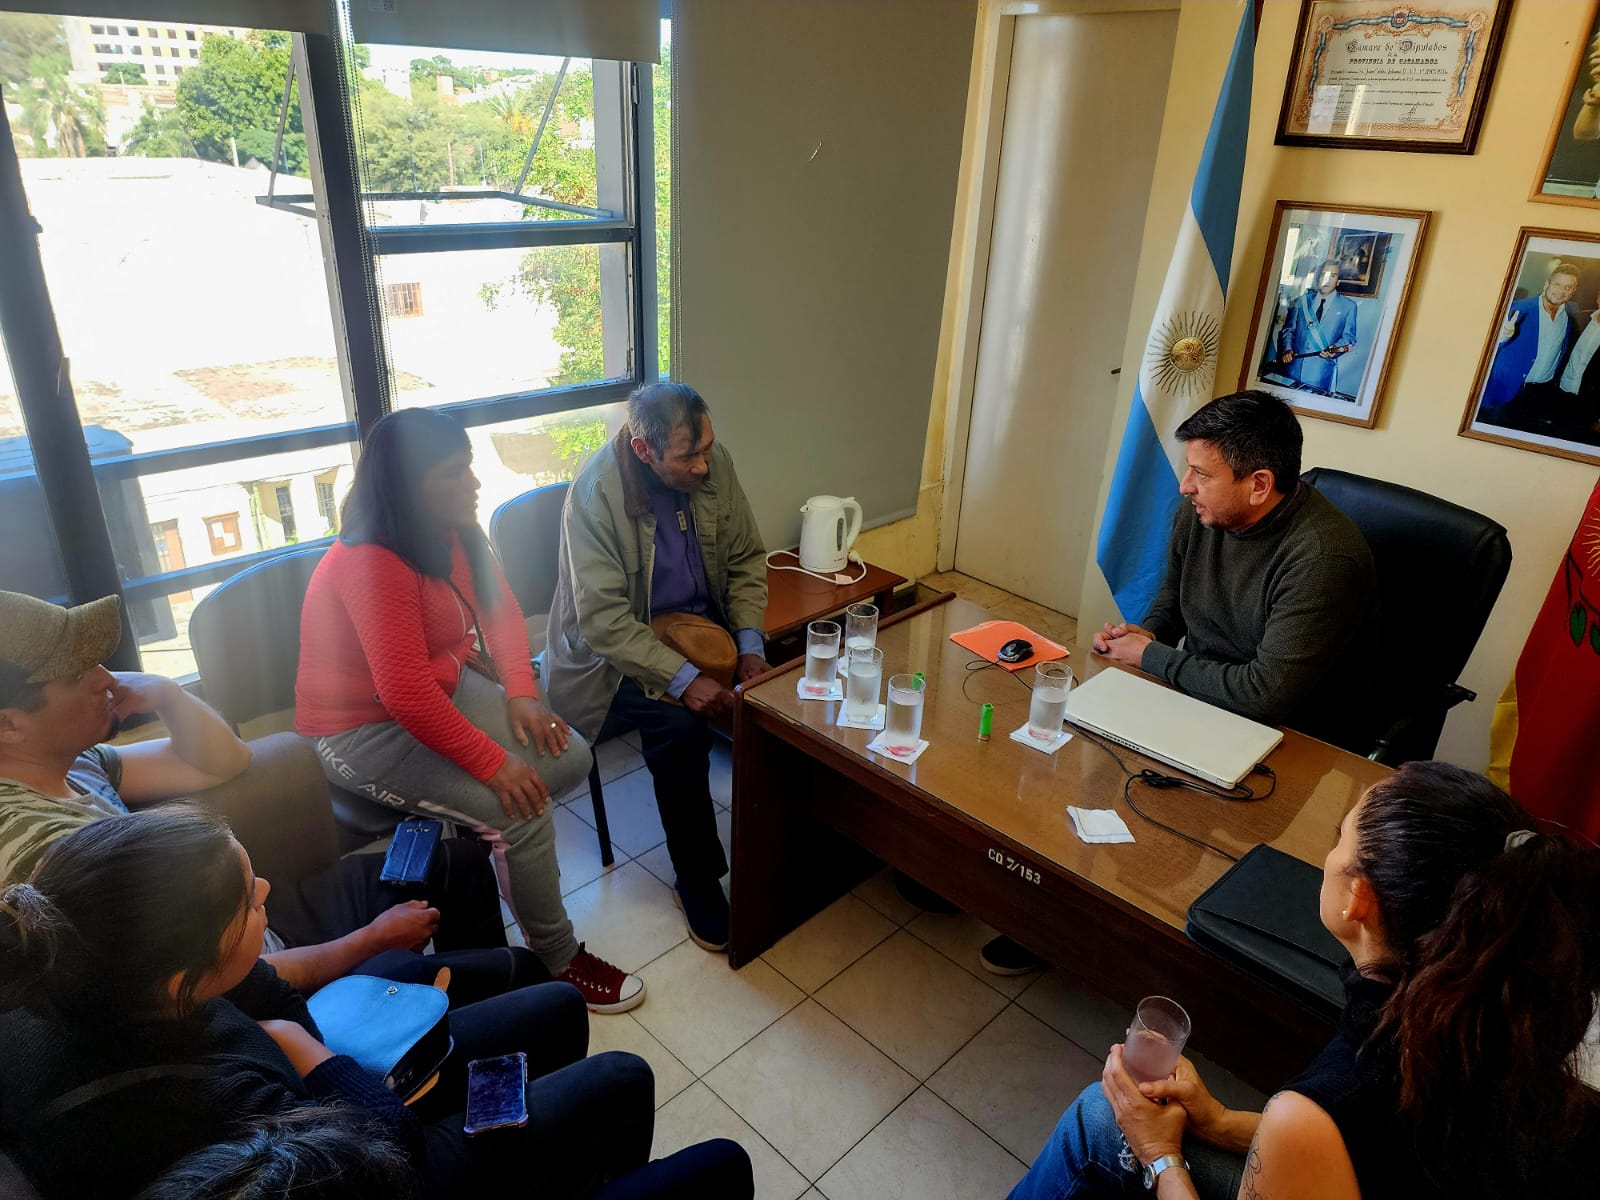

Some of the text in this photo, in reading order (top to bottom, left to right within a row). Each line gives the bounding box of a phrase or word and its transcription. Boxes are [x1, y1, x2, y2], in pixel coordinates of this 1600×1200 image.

[1399, 39, 1448, 54] Diputados
[314, 736, 406, 808] NIKE AIR
